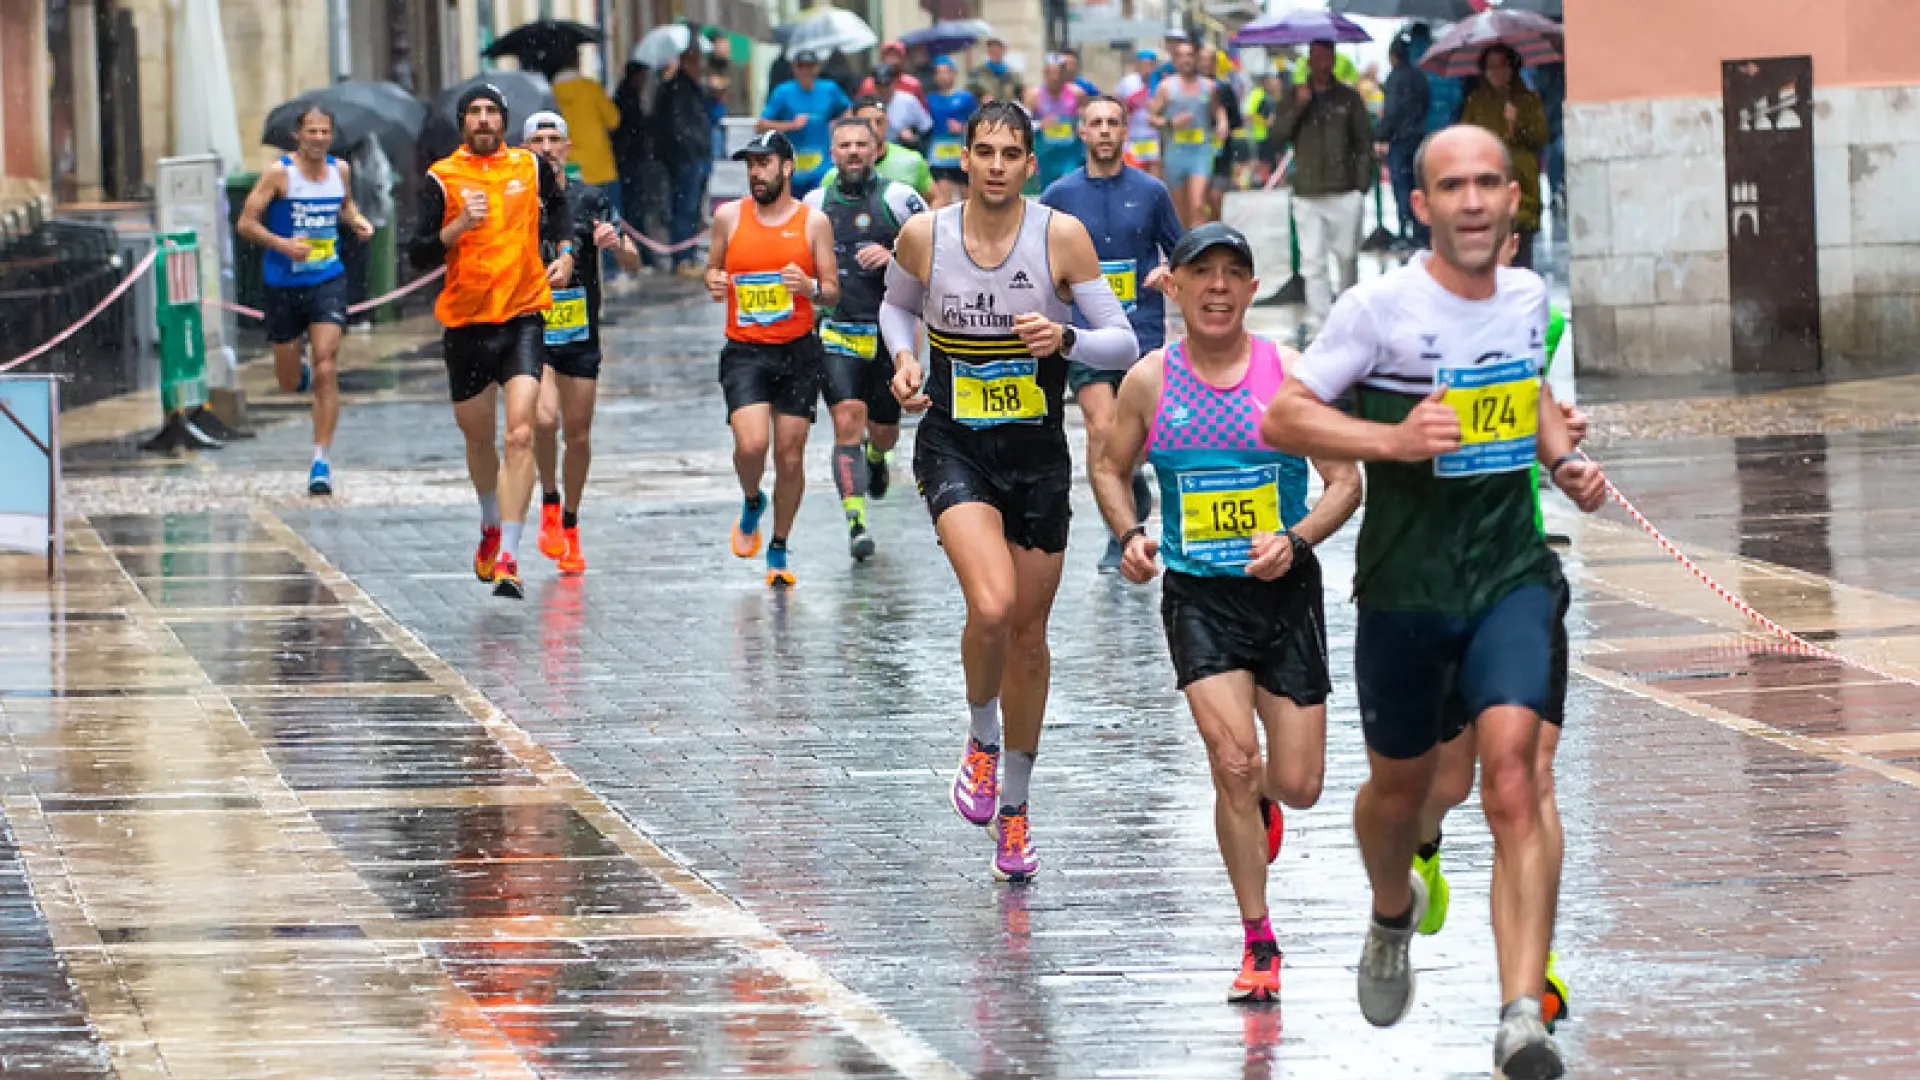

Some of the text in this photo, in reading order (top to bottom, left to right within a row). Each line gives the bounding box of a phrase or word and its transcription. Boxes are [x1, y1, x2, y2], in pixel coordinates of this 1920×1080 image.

[746, 290, 778, 309] 204
[981, 383, 1022, 413] 158
[1472, 394, 1517, 434] 124
[1212, 499, 1257, 532] 135
